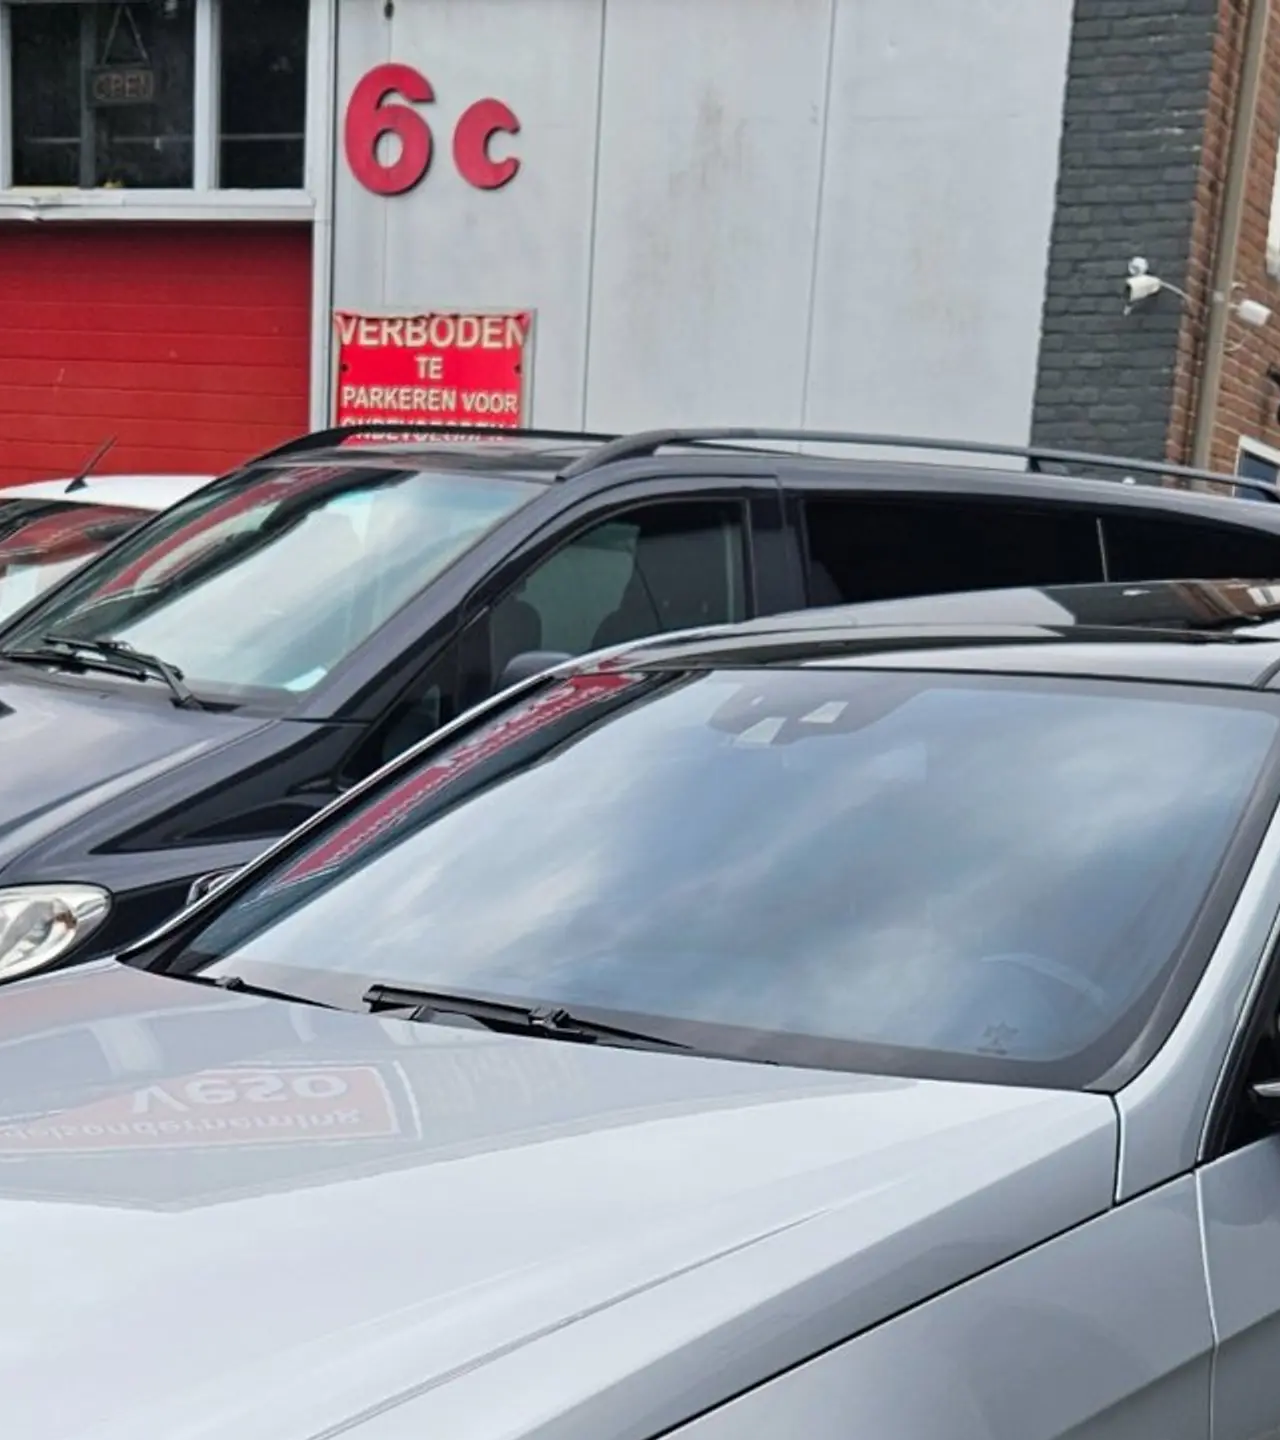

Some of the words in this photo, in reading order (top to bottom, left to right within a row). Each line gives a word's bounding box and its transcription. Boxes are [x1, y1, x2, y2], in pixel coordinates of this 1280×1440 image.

[335, 316, 524, 349] VERBODEN
[414, 355, 444, 380] TE
[342, 385, 457, 412] PARKEREN
[460, 391, 518, 414] VOOR
